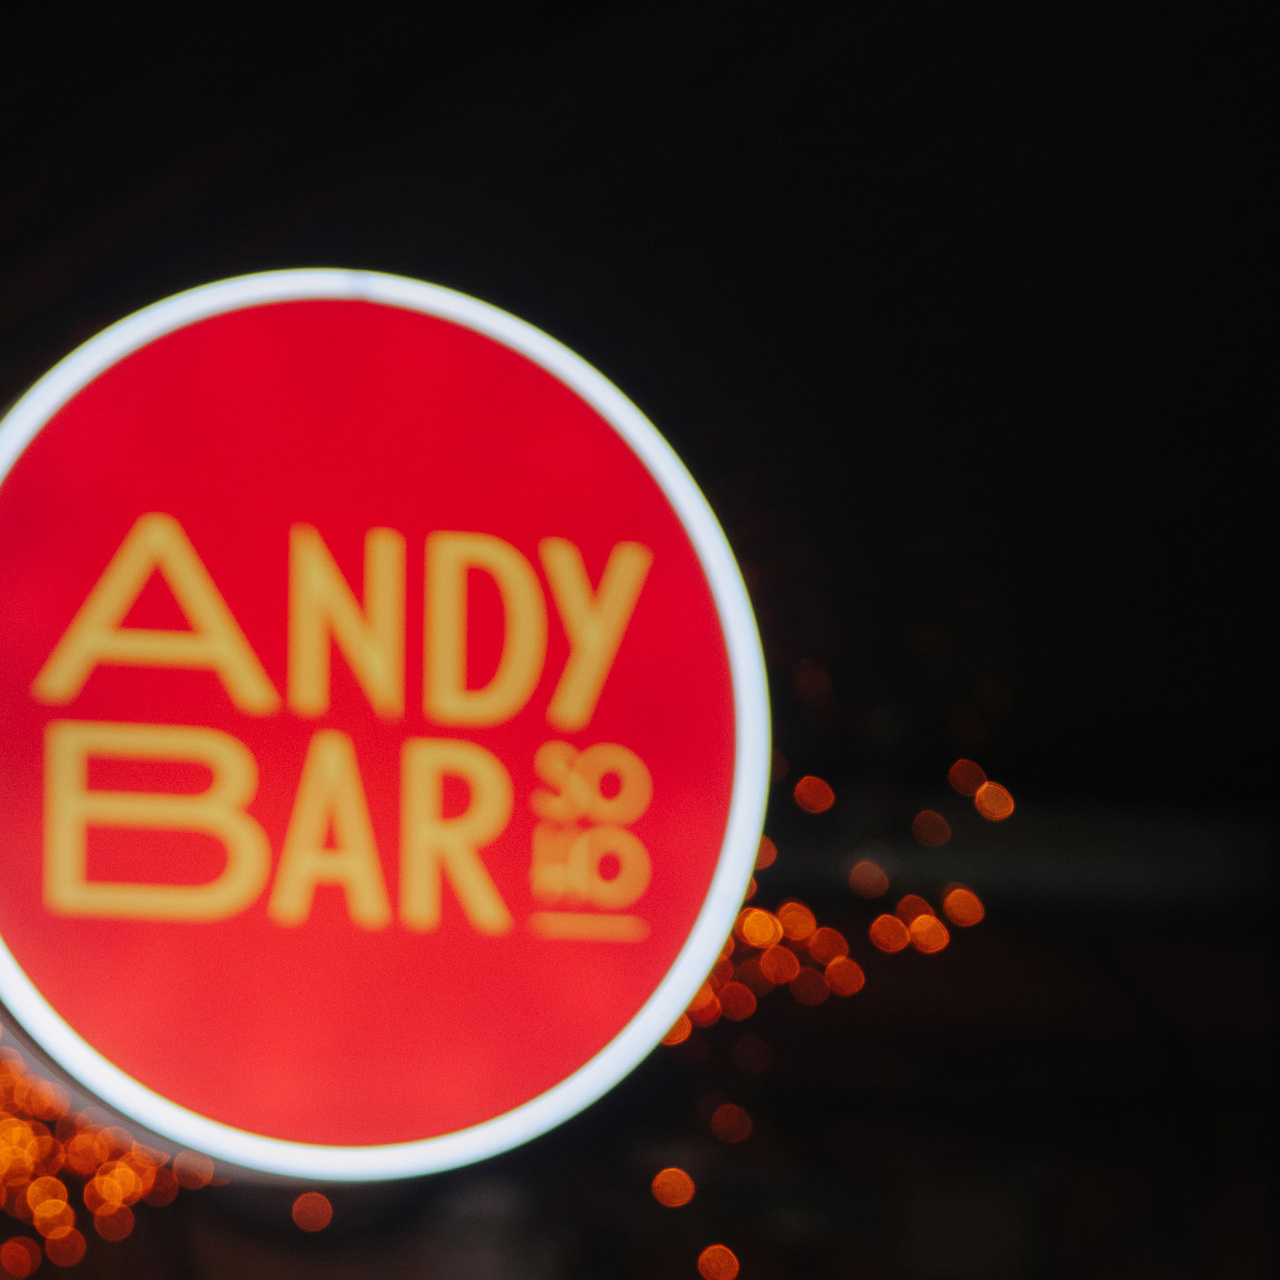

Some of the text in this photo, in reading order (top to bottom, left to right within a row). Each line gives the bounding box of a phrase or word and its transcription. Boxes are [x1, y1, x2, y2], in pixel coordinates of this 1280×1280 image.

[33, 512, 653, 732] ANDY
[43, 719, 514, 936] BAR
[530, 740, 653, 826] SO
